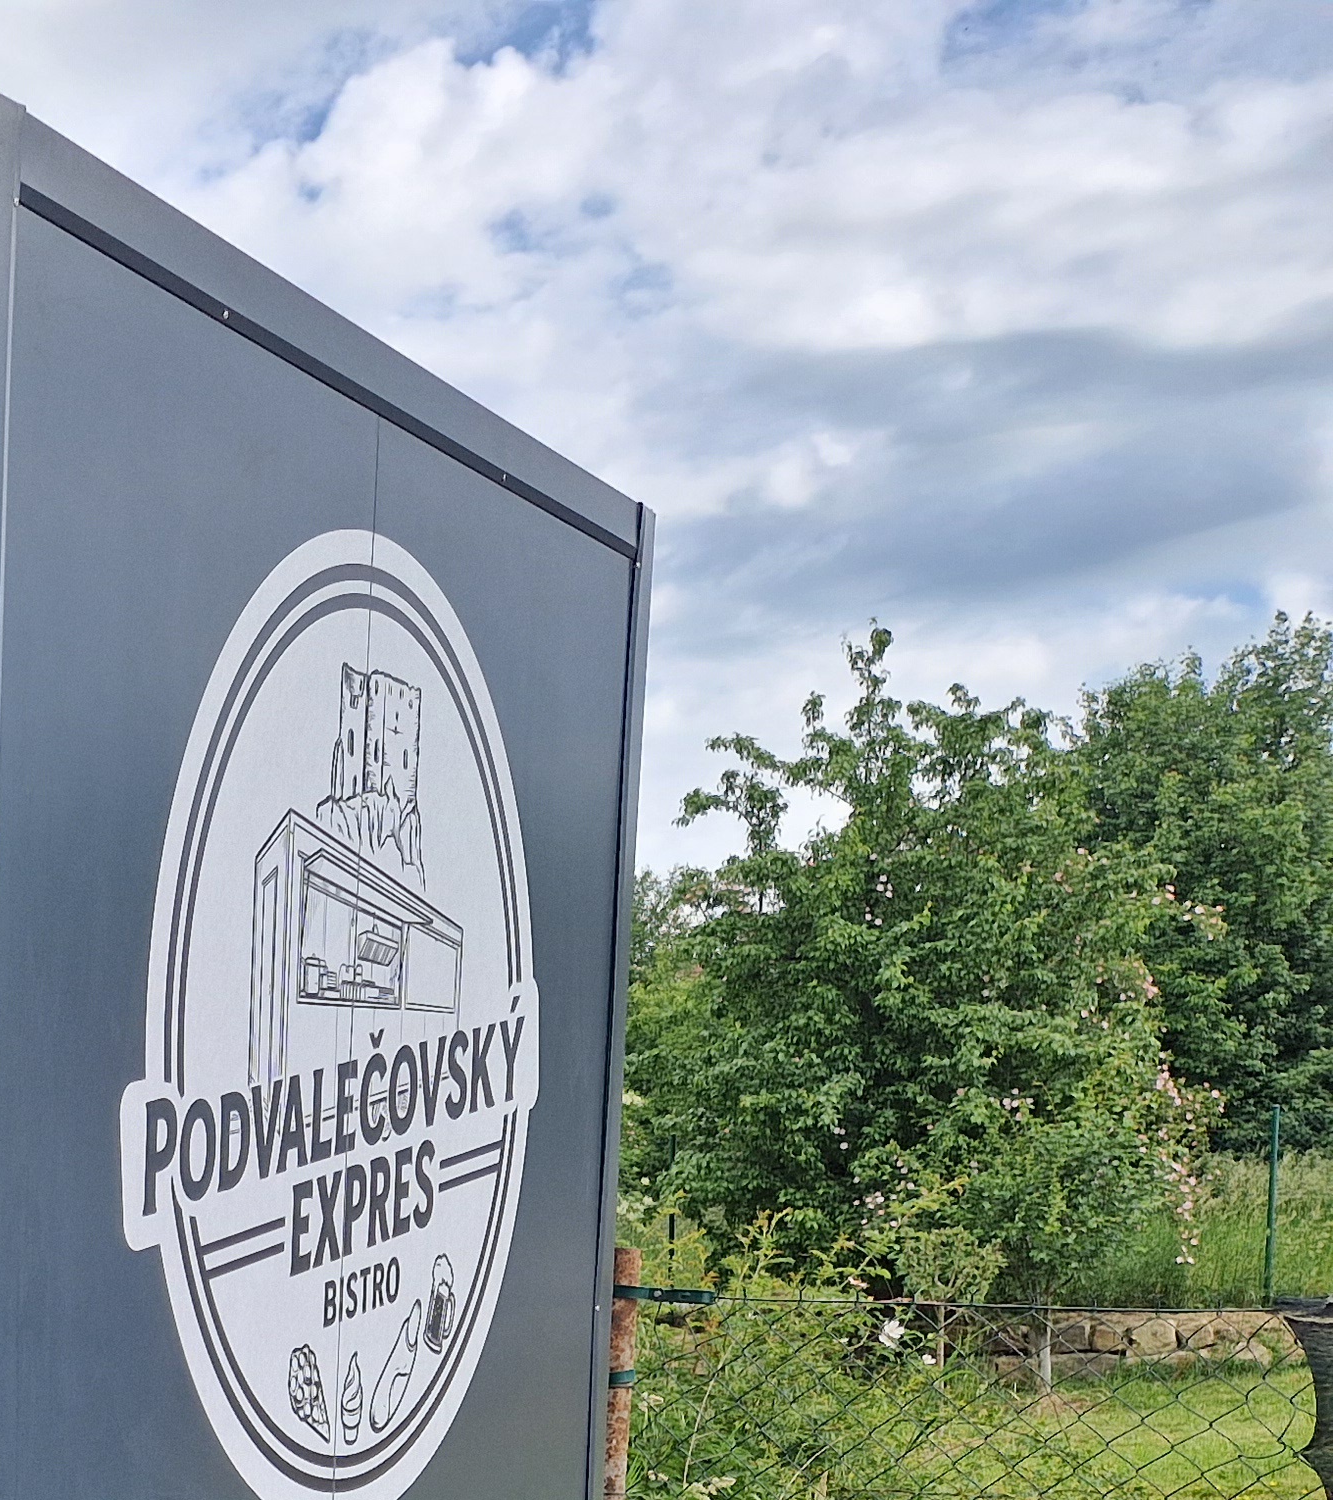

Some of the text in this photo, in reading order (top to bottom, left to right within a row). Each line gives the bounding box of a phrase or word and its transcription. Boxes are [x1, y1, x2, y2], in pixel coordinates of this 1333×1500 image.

[142, 996, 525, 1217] PODVALEČOVSKÝ
[290, 1140, 435, 1277] EXPRES
[324, 1256, 400, 1328] BISTRO
